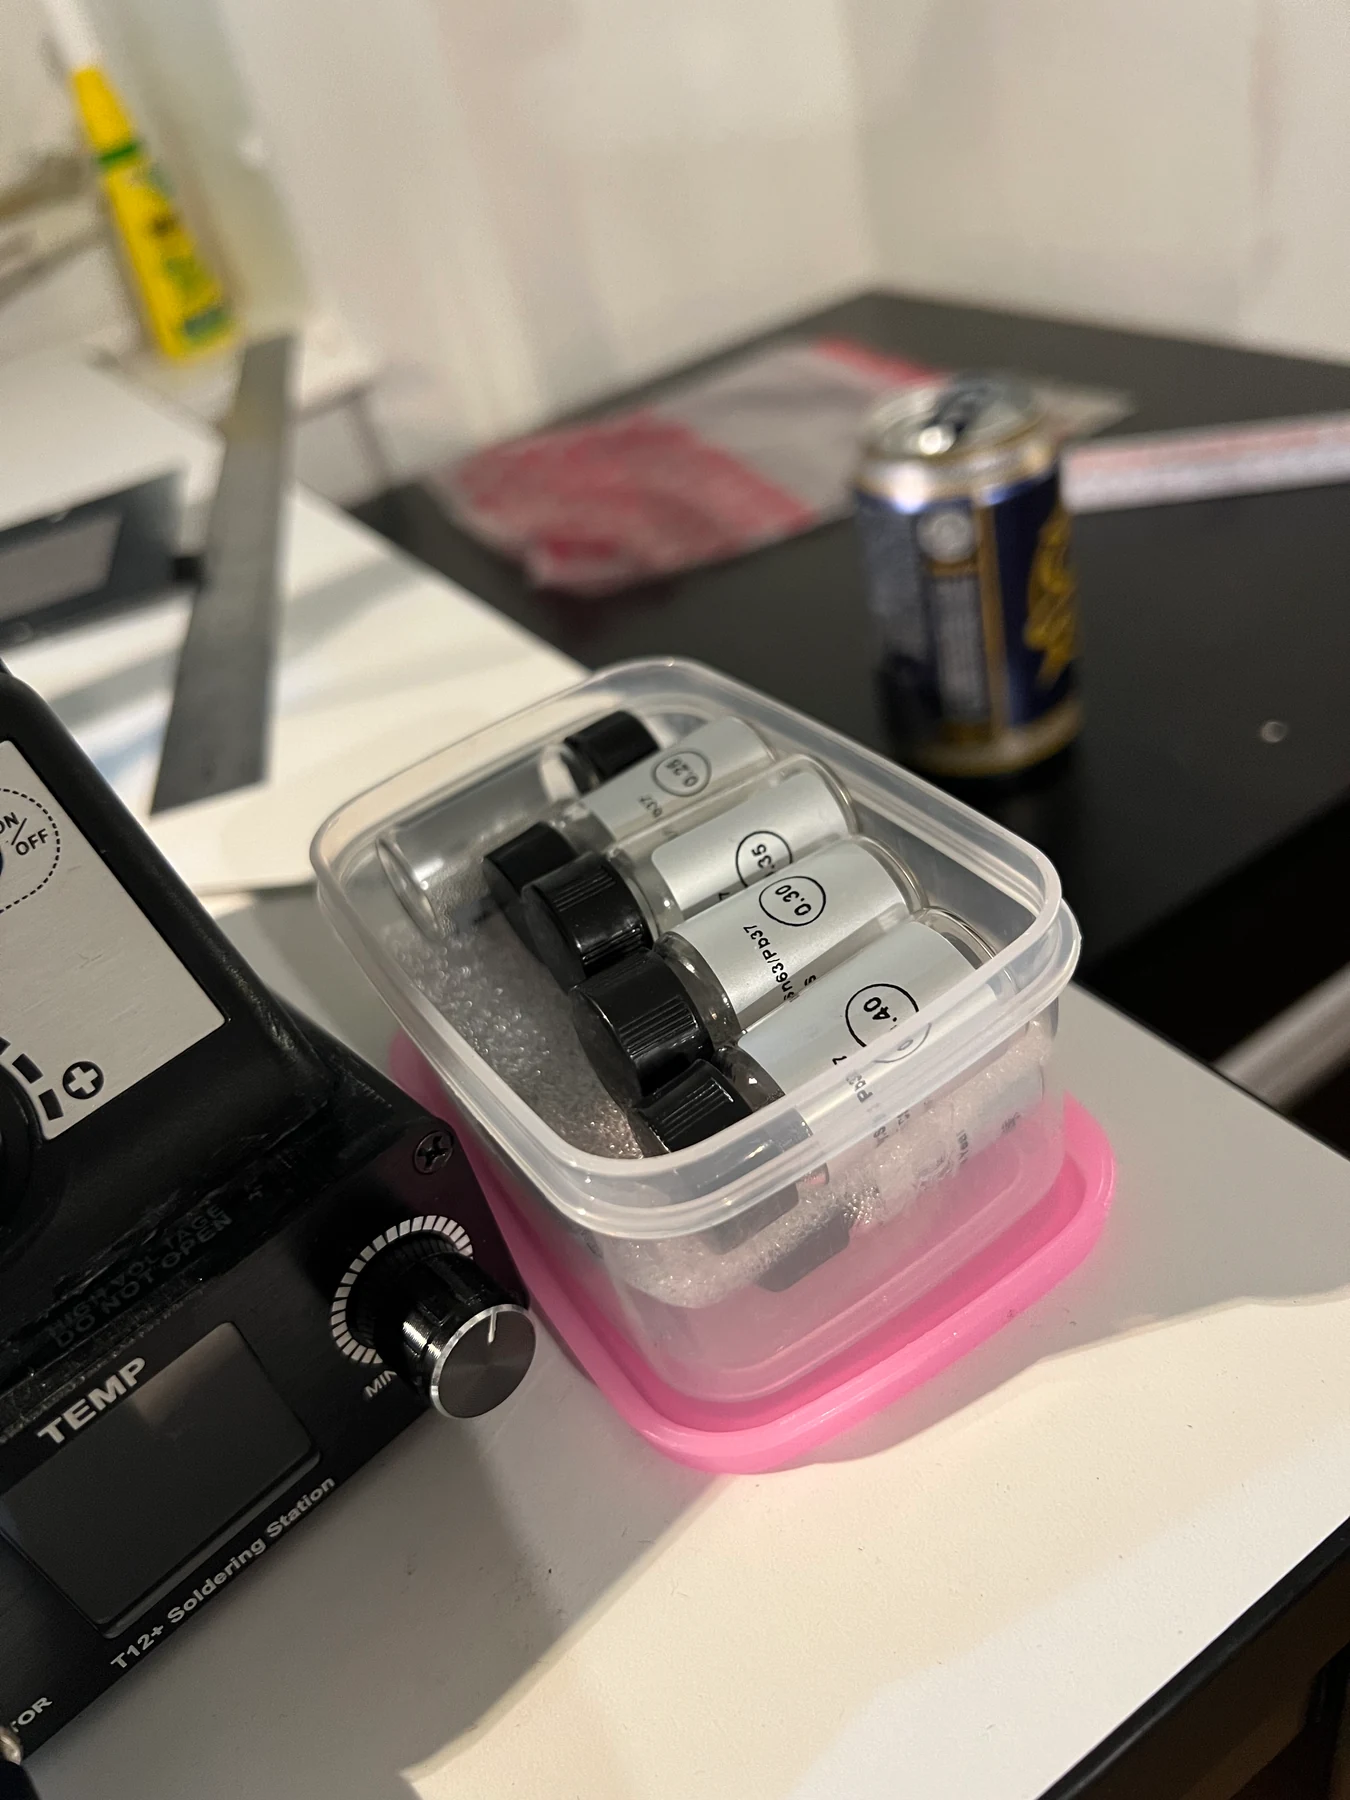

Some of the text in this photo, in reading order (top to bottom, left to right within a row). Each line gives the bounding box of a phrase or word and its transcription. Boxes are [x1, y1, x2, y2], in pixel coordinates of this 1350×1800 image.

[15, 828, 49, 856] OFF
[751, 843, 776, 877] .35
[774, 884, 812, 916] 0.30
[50, 1212, 233, 1348] DO NOT OPEN
[37, 1357, 146, 1444] TEMP
[110, 1477, 336, 1669] T12+ Soldering Station
